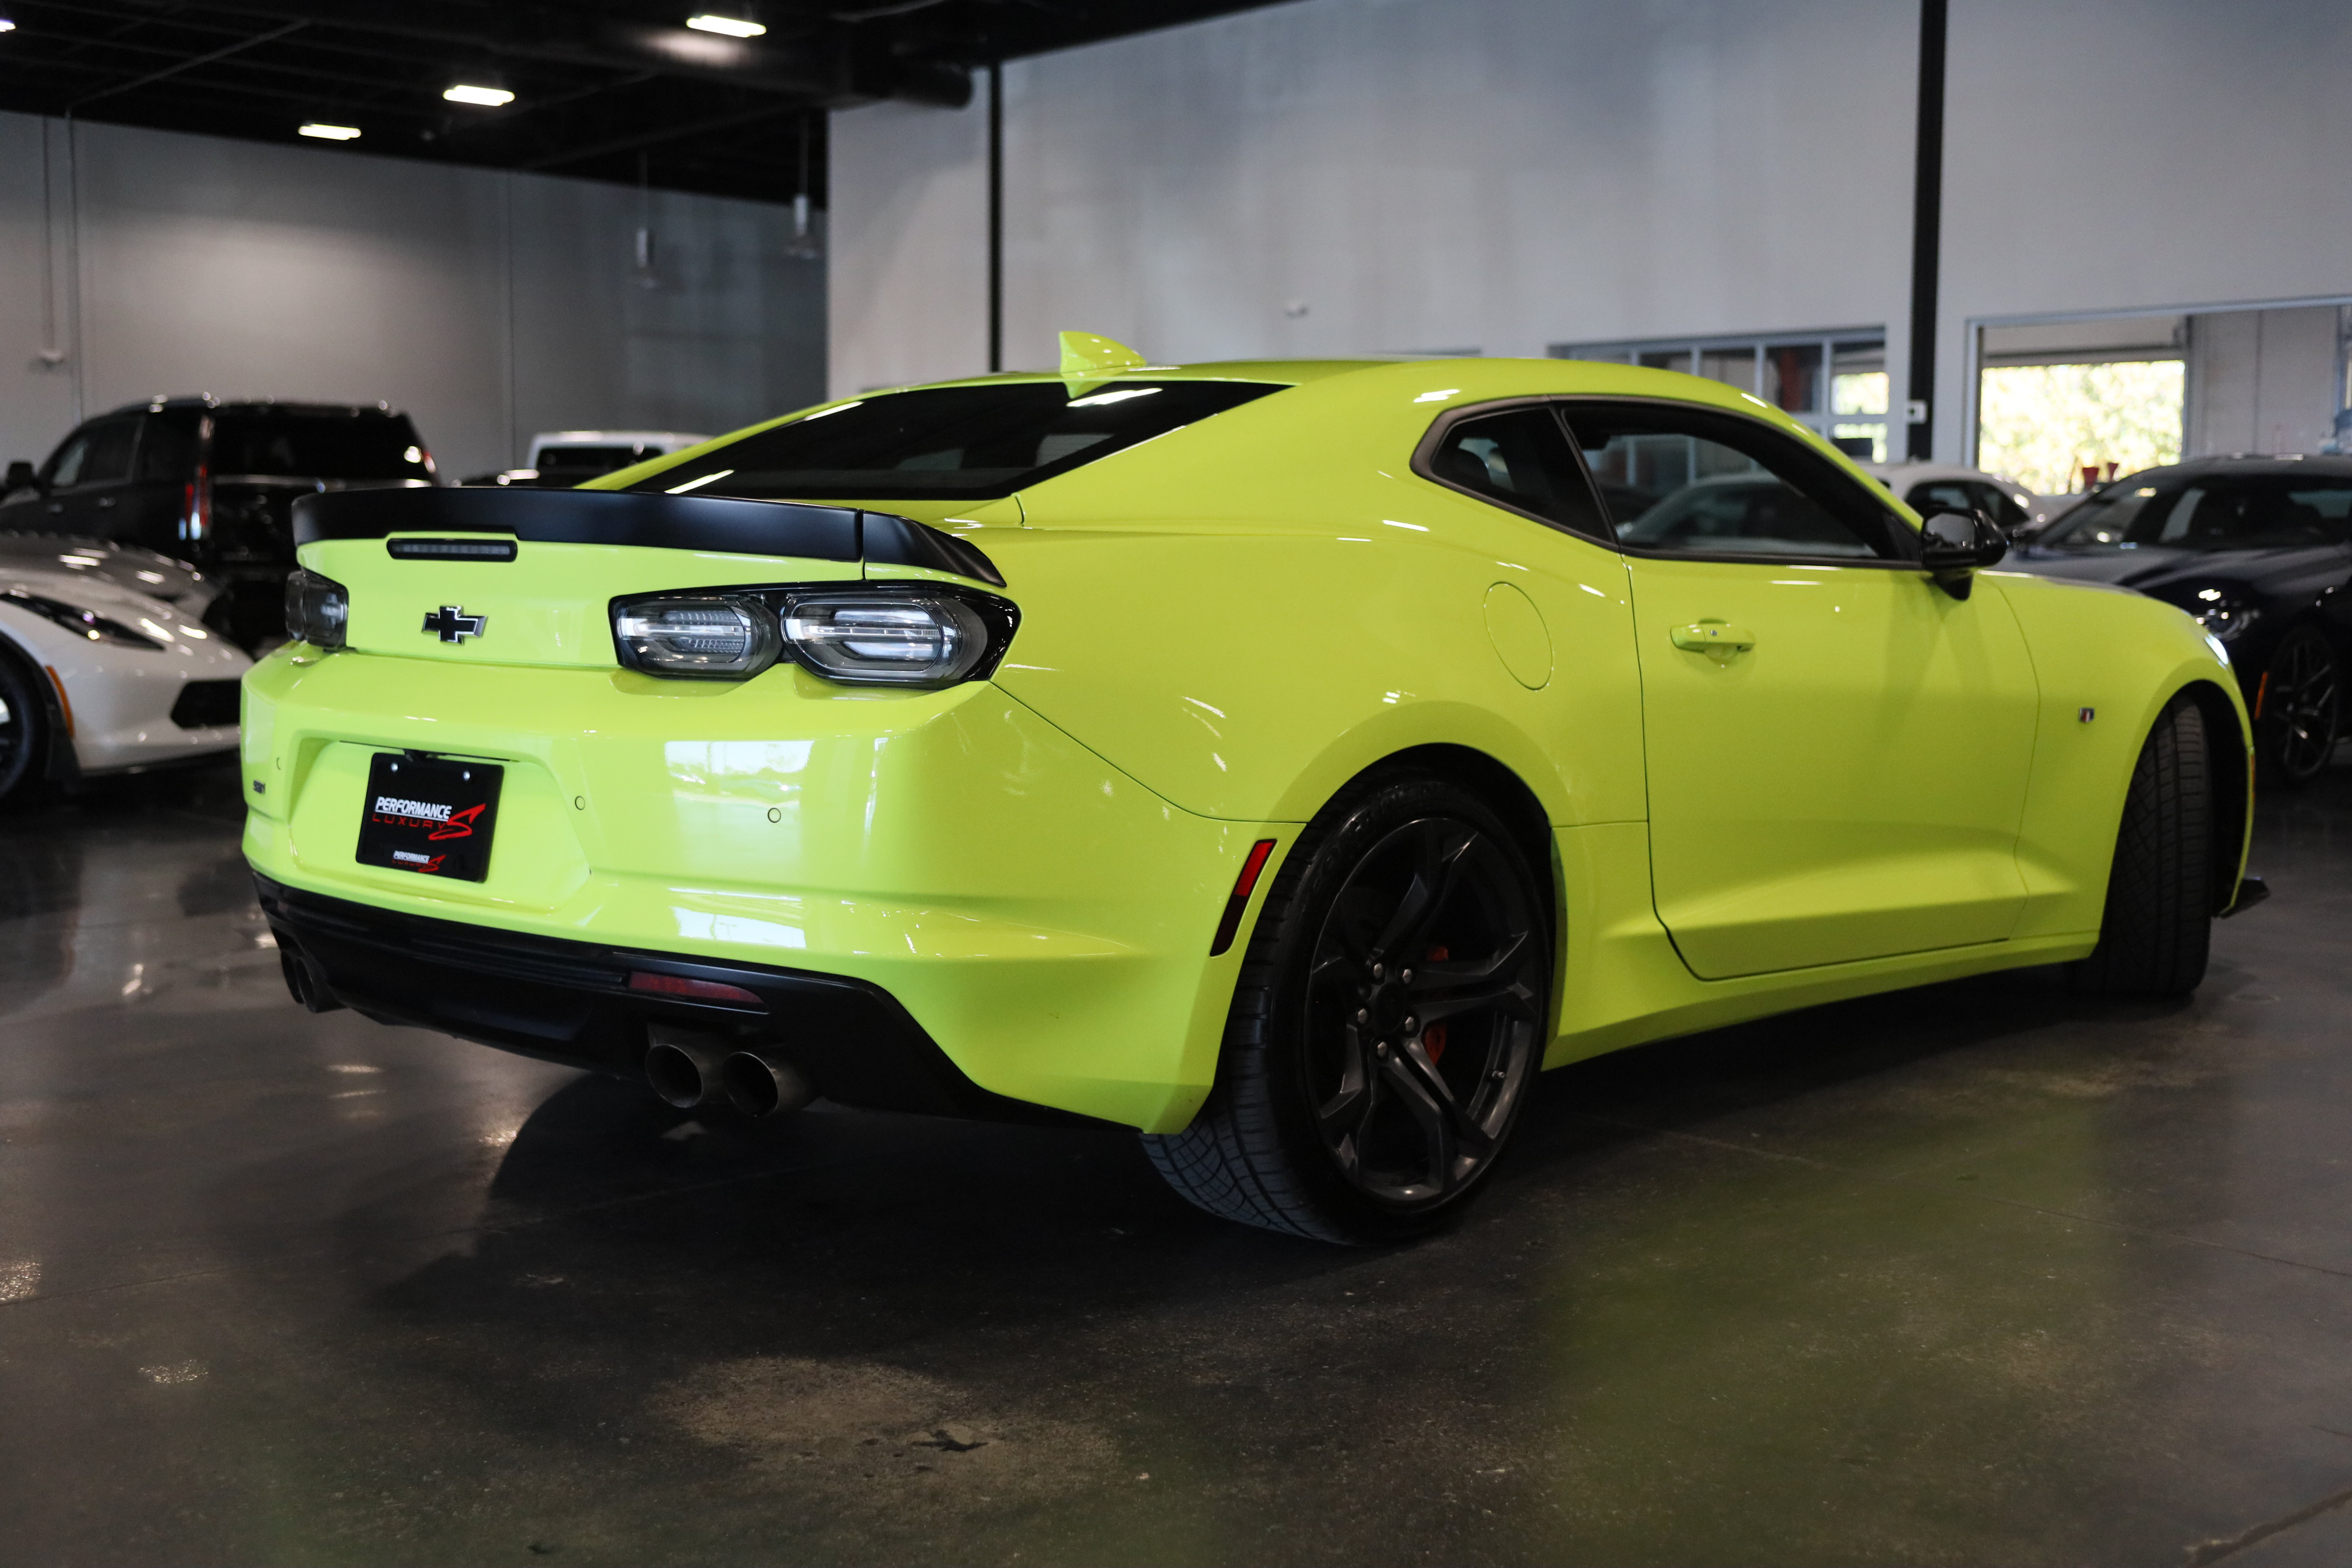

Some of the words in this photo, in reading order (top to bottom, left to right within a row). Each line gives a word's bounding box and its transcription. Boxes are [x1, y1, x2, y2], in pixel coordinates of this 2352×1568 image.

[375, 796, 452, 820] PERFORMANCE
[372, 813, 448, 831] LUXURY
[393, 850, 430, 864] PERFORMANCE
